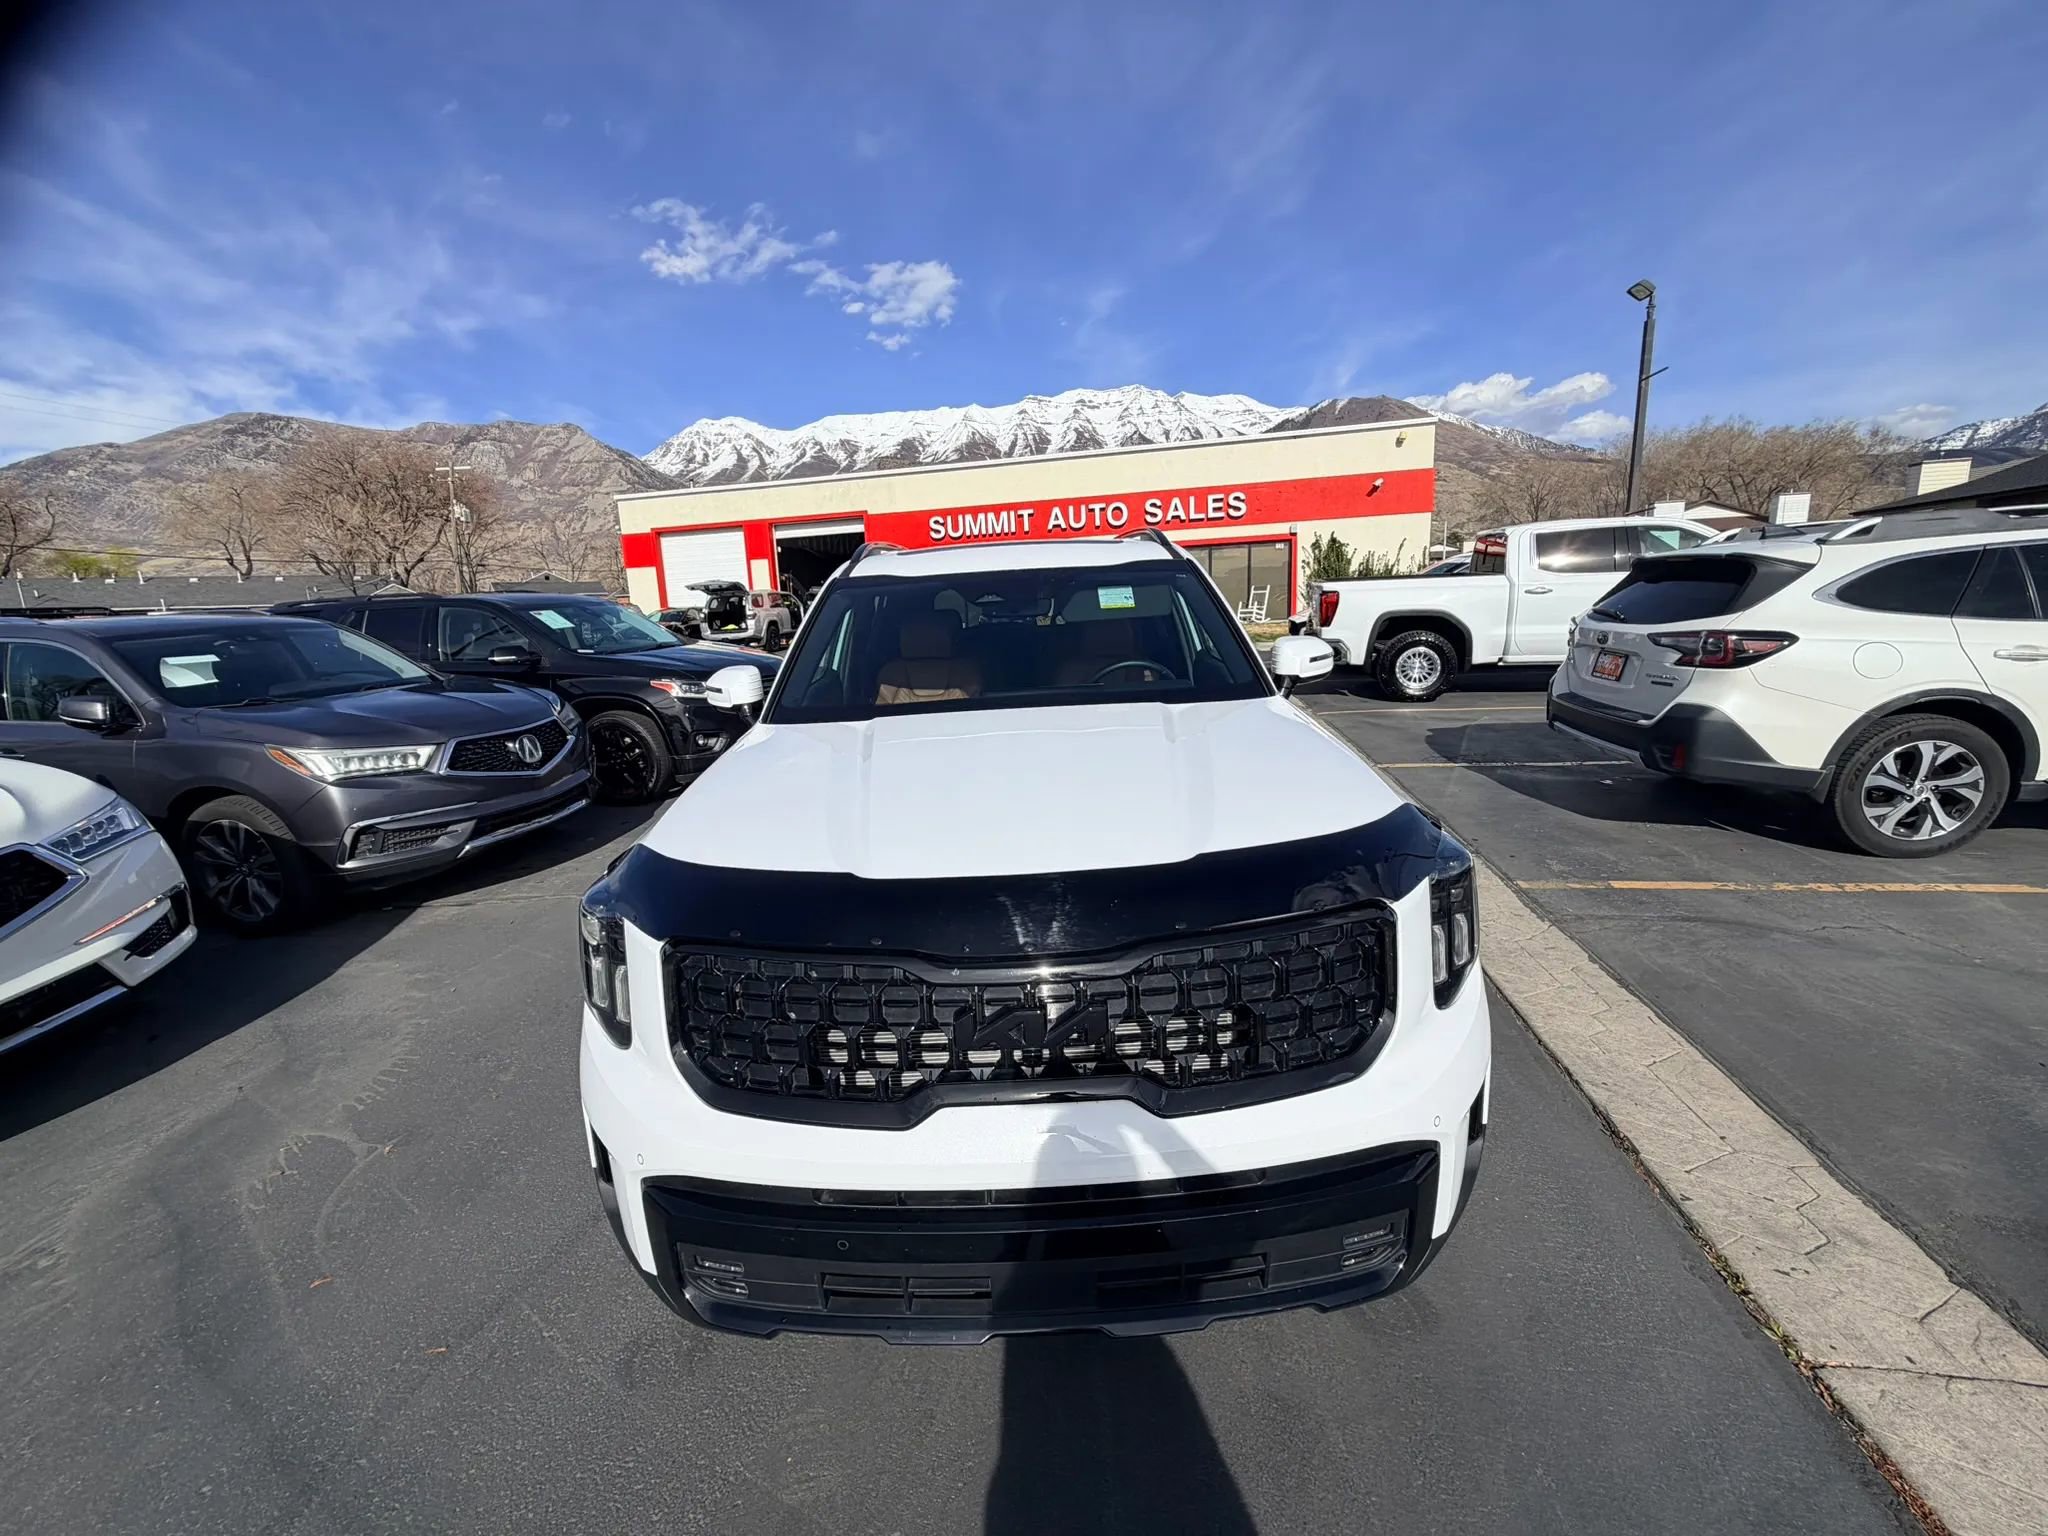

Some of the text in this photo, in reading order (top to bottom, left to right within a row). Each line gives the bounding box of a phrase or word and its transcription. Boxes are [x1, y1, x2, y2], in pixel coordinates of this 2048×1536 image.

[928, 491, 1248, 540] SUMMIT AUTO SALES
[953, 1001, 1109, 1052] KIA
